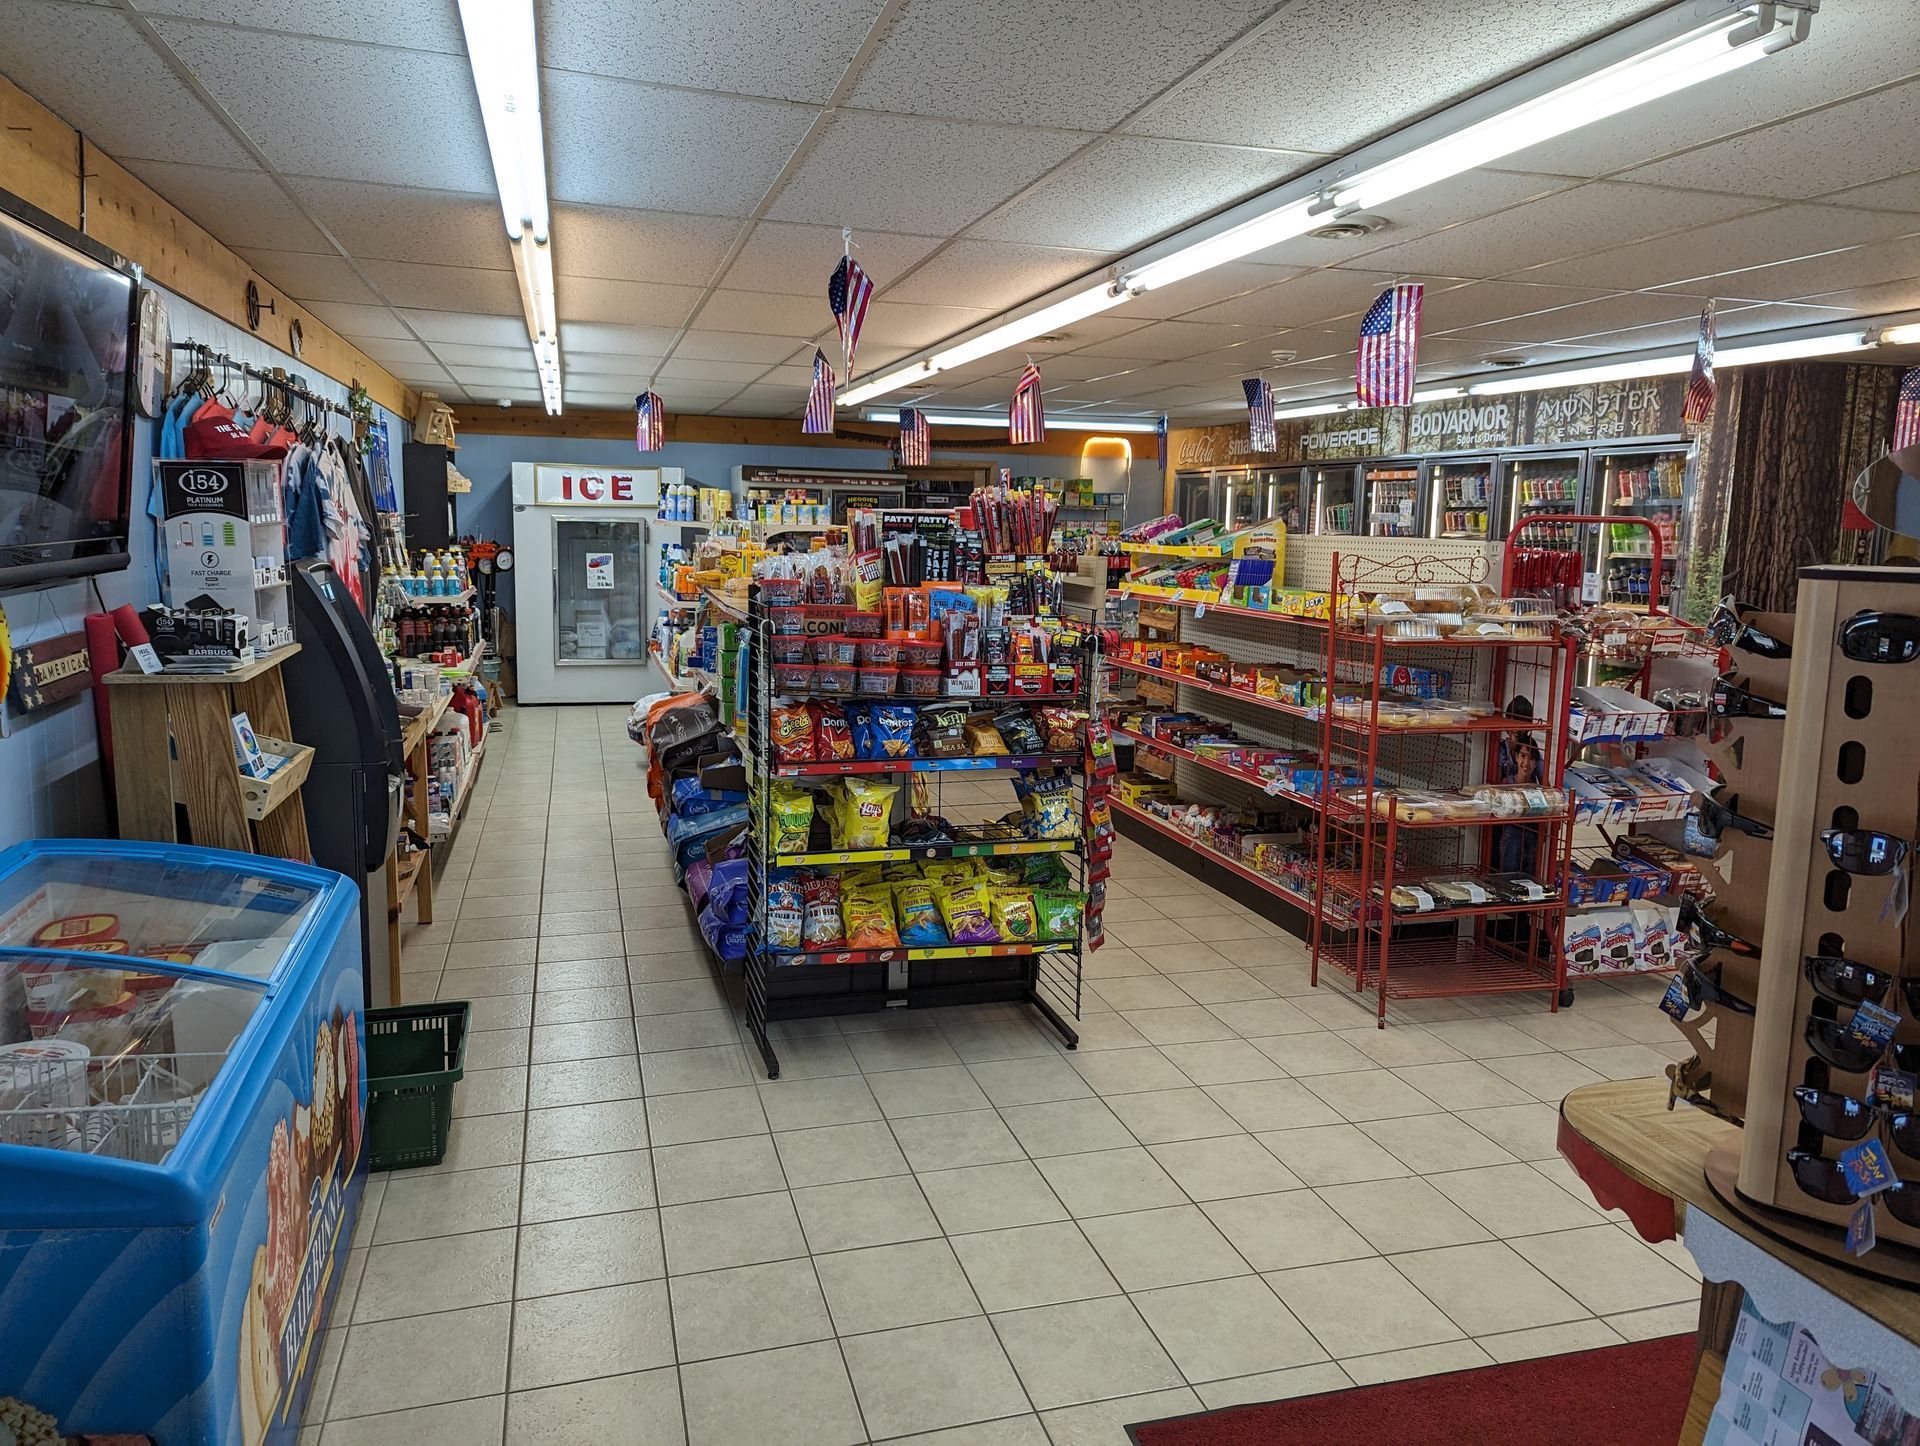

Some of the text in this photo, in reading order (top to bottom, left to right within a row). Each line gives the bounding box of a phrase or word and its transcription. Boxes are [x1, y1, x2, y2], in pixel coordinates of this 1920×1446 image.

[1541, 387, 1660, 423] MONSTER
[214, 424, 233, 433] THE
[1411, 404, 1509, 438] BODYARMOR
[1557, 420, 1640, 438] ENERGY
[1300, 427, 1380, 450] POWERADE
[1456, 431, 1507, 445] Sports Drink
[562, 472, 634, 501] ICE
[186, 496, 224, 504] PLATINUM
[884, 515, 915, 523] FATTY
[1304, 596, 1325, 608] DOTS
[41, 658, 82, 680] AMERICA
[780, 715, 811, 738] Cheetos
[942, 743, 954, 752] SEA
[860, 802, 882, 817] Lay's
[948, 905, 965, 914] FIESTA
[1570, 937, 1597, 953] donettes
[1606, 934, 1632, 949] donettes
[312, 1169, 343, 1291] BUNNY
[285, 1277, 312, 1383] BLUE
